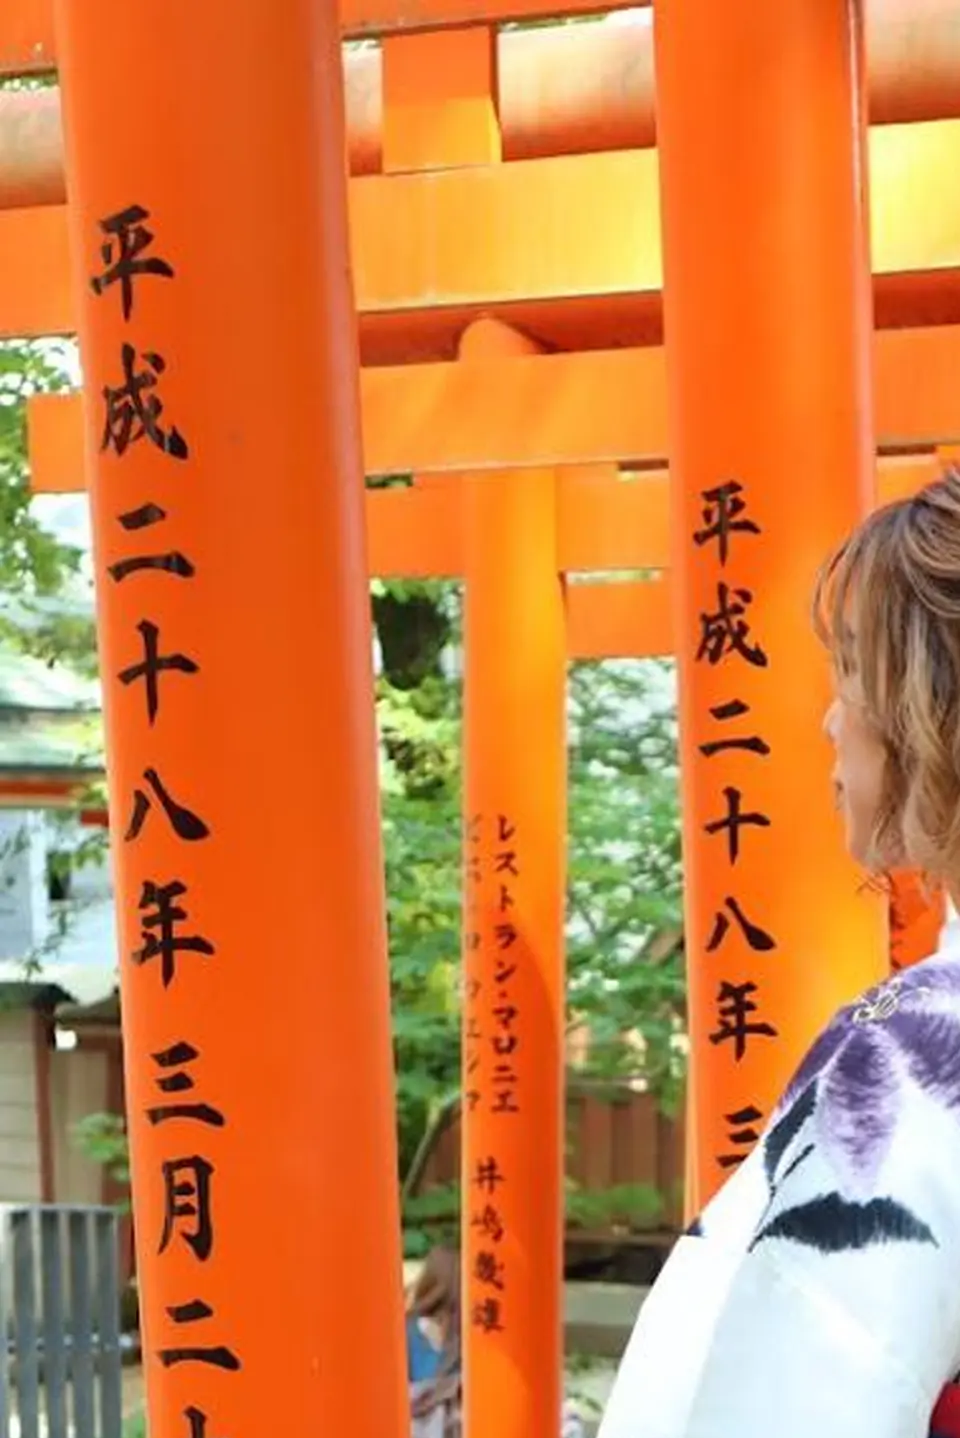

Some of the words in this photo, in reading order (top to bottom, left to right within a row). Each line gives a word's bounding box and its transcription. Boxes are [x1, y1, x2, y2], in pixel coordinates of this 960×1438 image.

[693, 480, 777, 1168] 平成二十八年三
